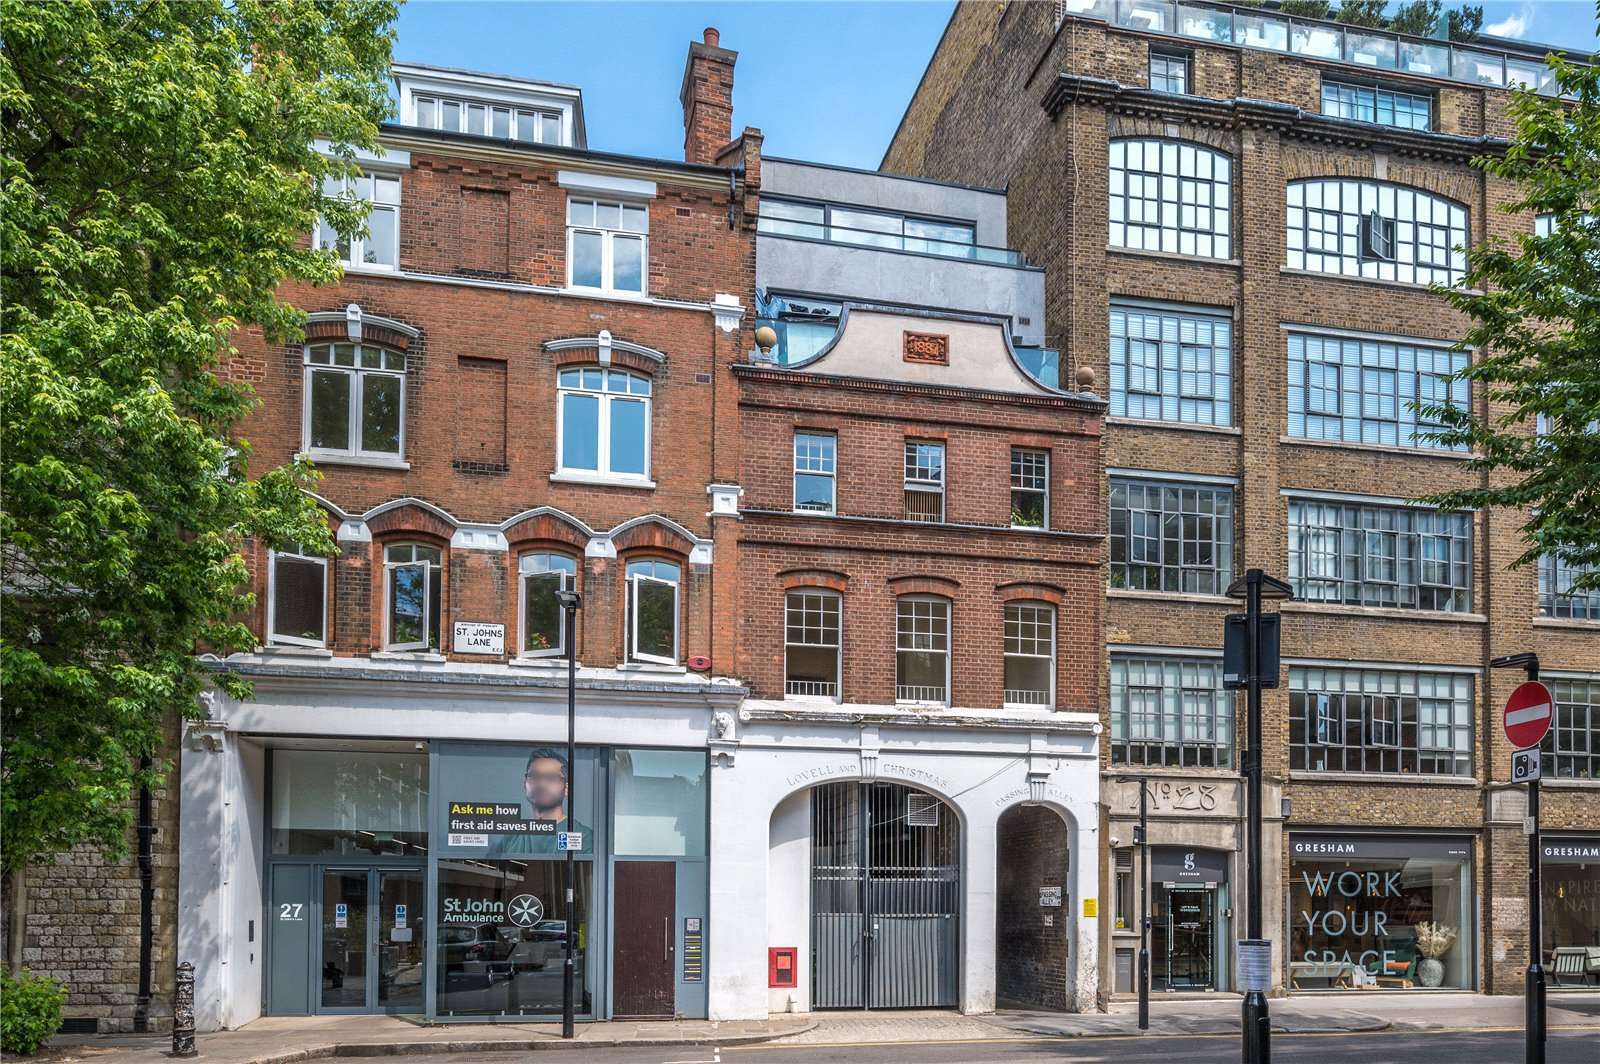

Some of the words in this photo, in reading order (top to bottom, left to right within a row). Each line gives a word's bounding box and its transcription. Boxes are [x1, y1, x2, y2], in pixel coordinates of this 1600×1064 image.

[456, 628, 469, 636] ST.
[473, 629, 503, 638] JOHNS
[467, 638, 491, 647] LANE
[785, 765, 835, 788] LOVELL
[883, 763, 948, 789] CHRISTMAS
[1173, 784, 1216, 811] 28
[451, 804, 474, 815] Ask
[476, 806, 494, 815] me
[495, 805, 519, 816] how
[451, 820, 475, 830] first
[477, 821, 494, 831] aid
[496, 823, 527, 831] saves
[529, 821, 554, 832] lives
[1295, 844, 1355, 853] GRESHAM
[1544, 847, 1599, 857] GRESHAM
[1302, 870, 1402, 898] WORK
[279, 903, 303, 918] 27
[443, 898, 462, 913] St
[463, 898, 504, 913] John
[443, 912, 504, 923] Ambulance
[1302, 910, 1389, 937] YOUR
[1303, 949, 1397, 976] SPACE
